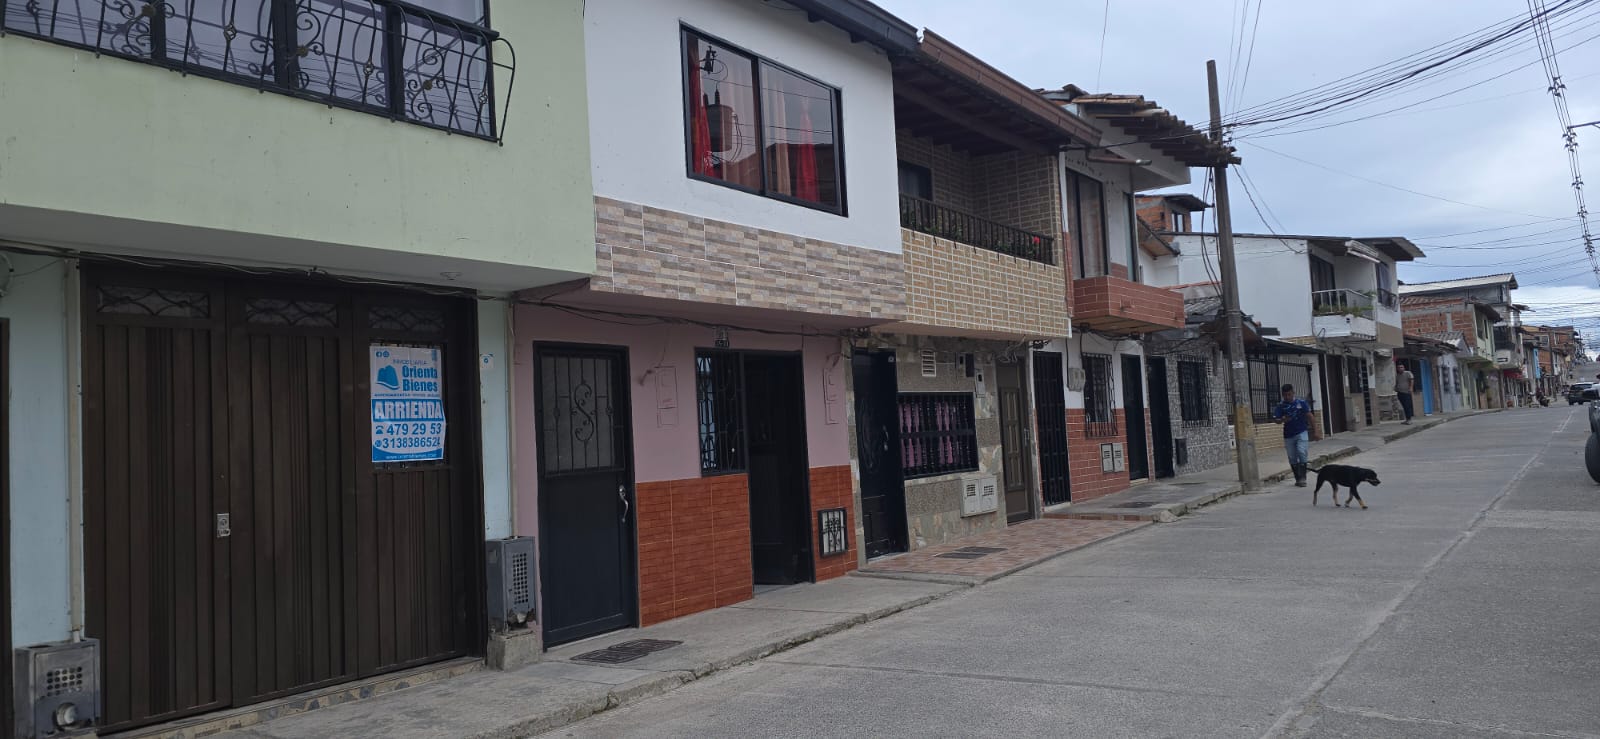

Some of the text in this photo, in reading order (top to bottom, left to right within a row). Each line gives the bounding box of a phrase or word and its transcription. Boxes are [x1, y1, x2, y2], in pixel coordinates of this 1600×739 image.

[402, 365, 438, 379] Orienta
[402, 379, 438, 392] Bienes
[374, 401, 443, 419] ARRIENDA
[386, 422, 442, 435] 479 29 53
